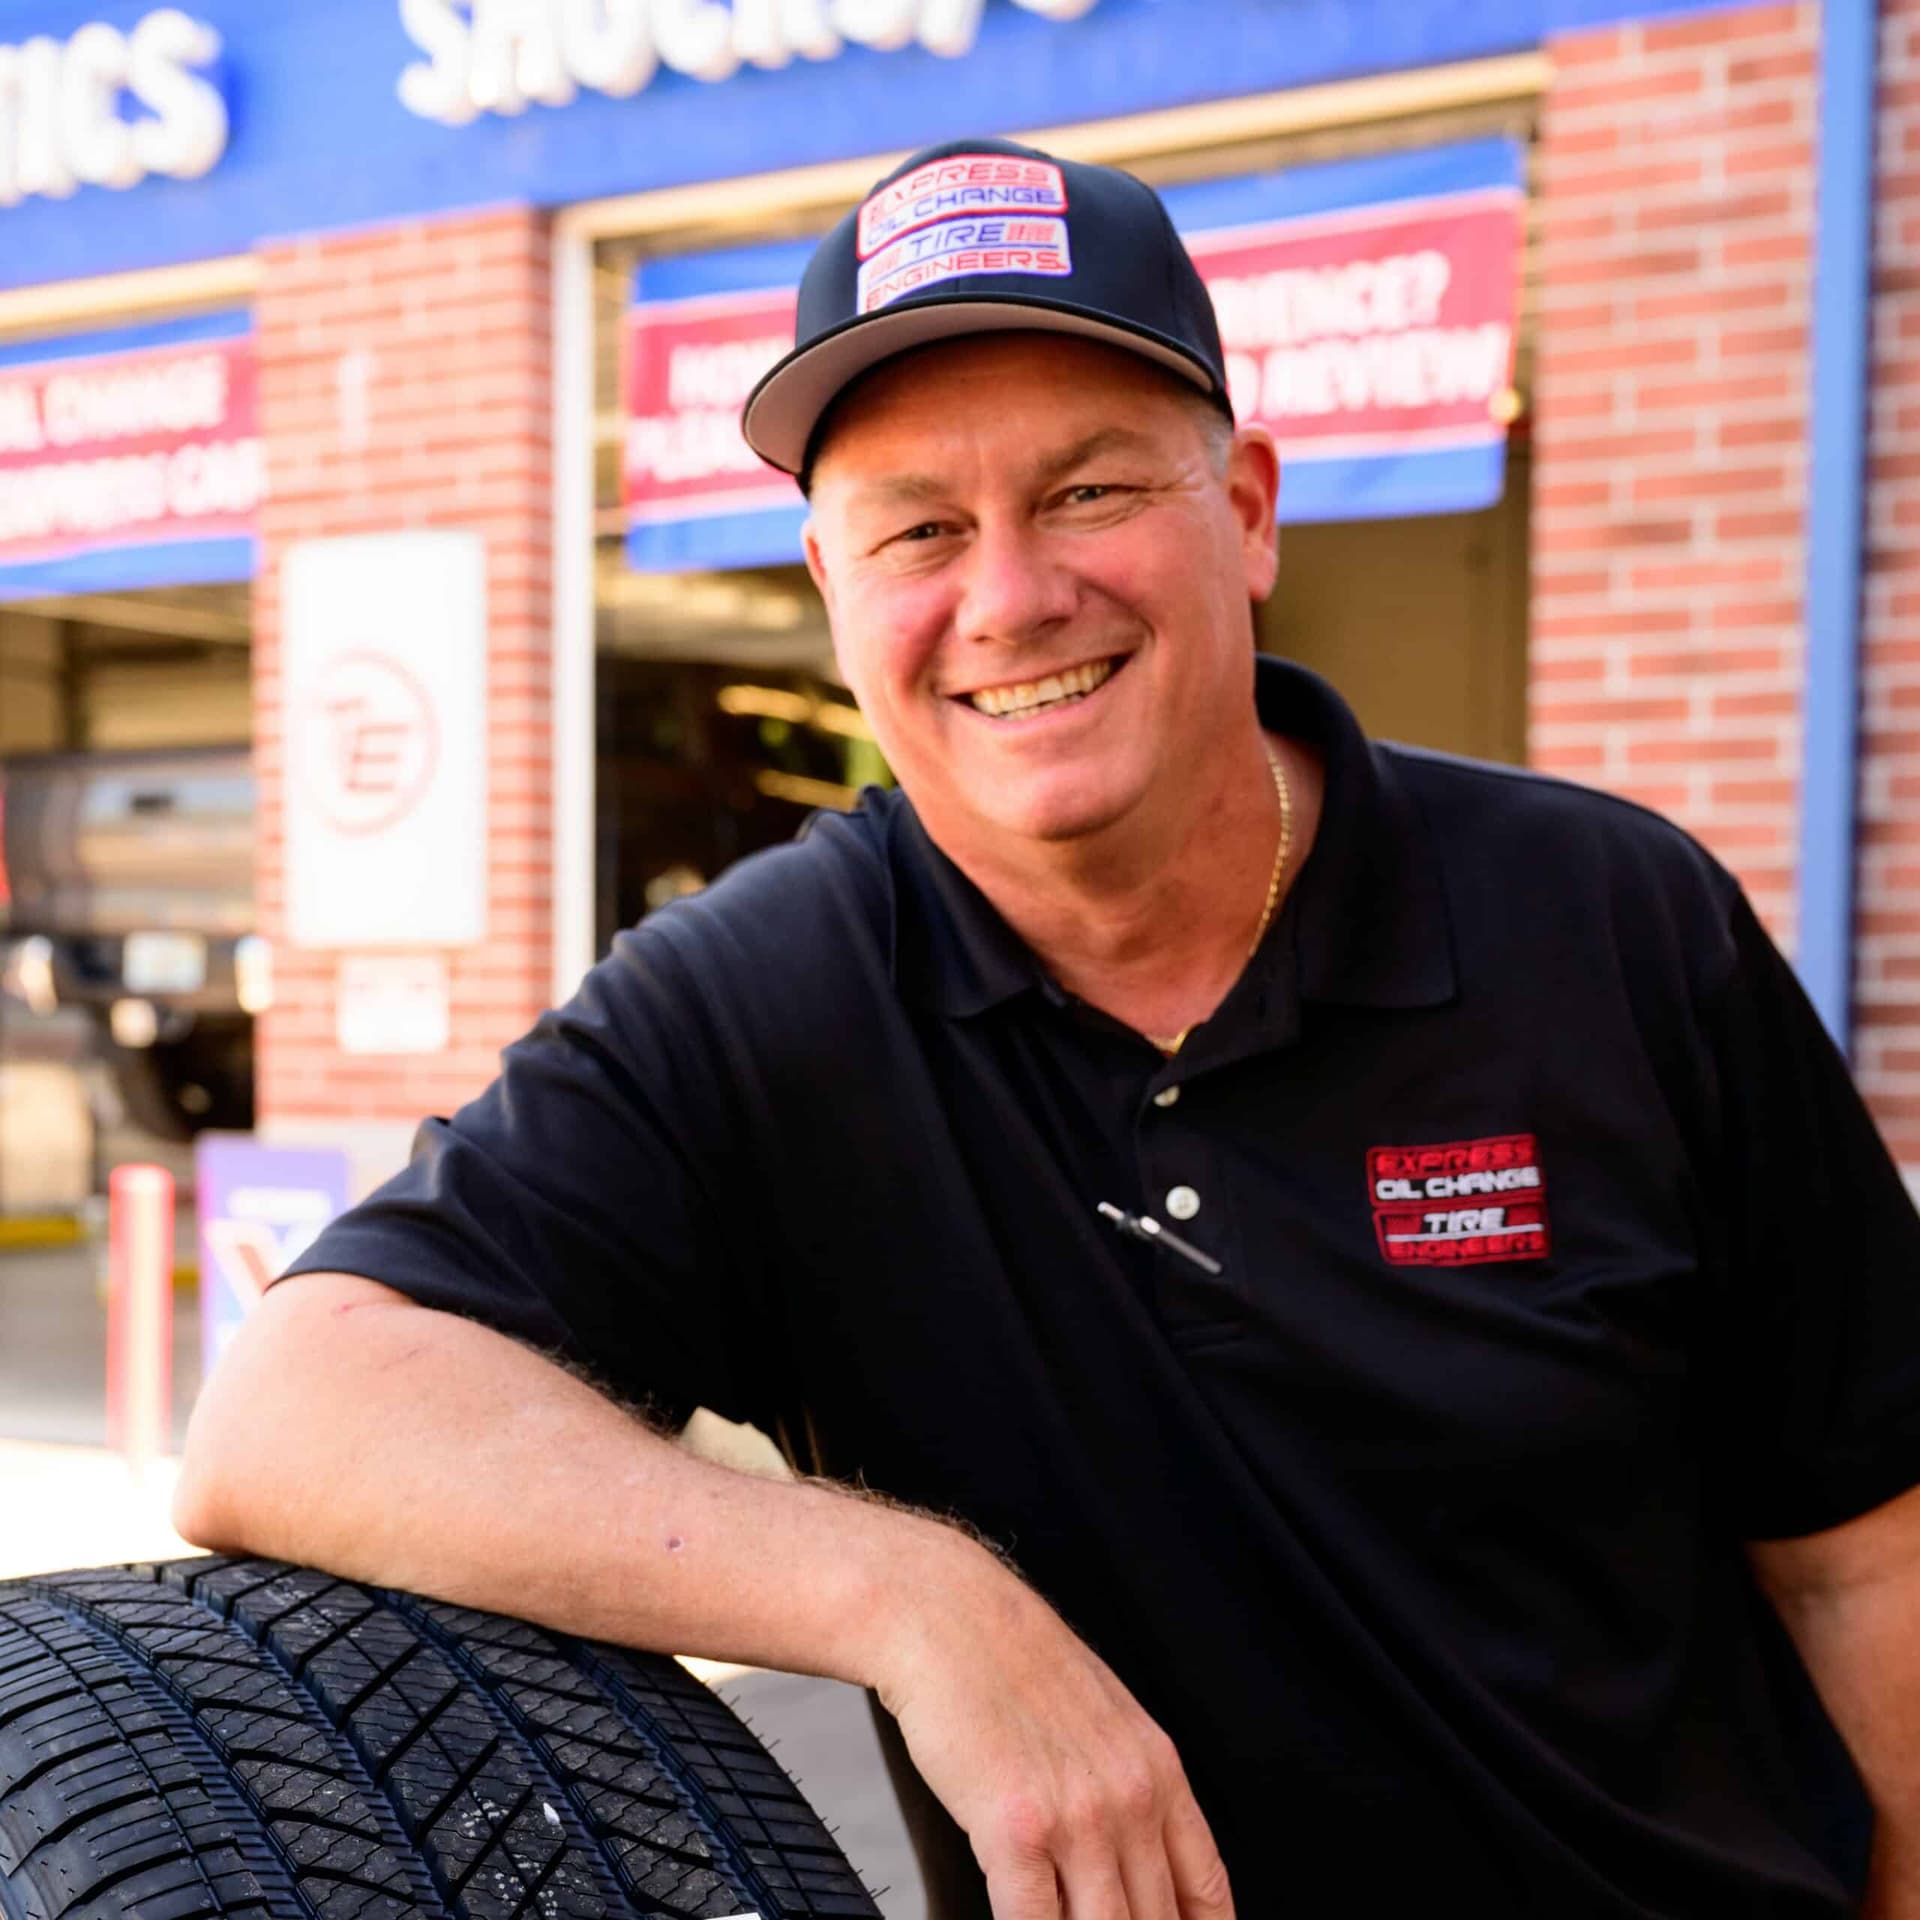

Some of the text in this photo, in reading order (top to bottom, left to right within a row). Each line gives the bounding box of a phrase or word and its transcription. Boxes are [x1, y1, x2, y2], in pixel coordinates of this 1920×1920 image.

[868, 162, 1050, 225] EXPRESS
[912, 186, 1064, 219] CHANGE
[908, 221, 1006, 258] TIRE
[865, 249, 1068, 314] ENGINEERS
[1375, 1141, 1534, 1177] EXPRESS
[1375, 1166, 1541, 1201] OIL CHANGE
[1423, 1207, 1505, 1234] TIRE
